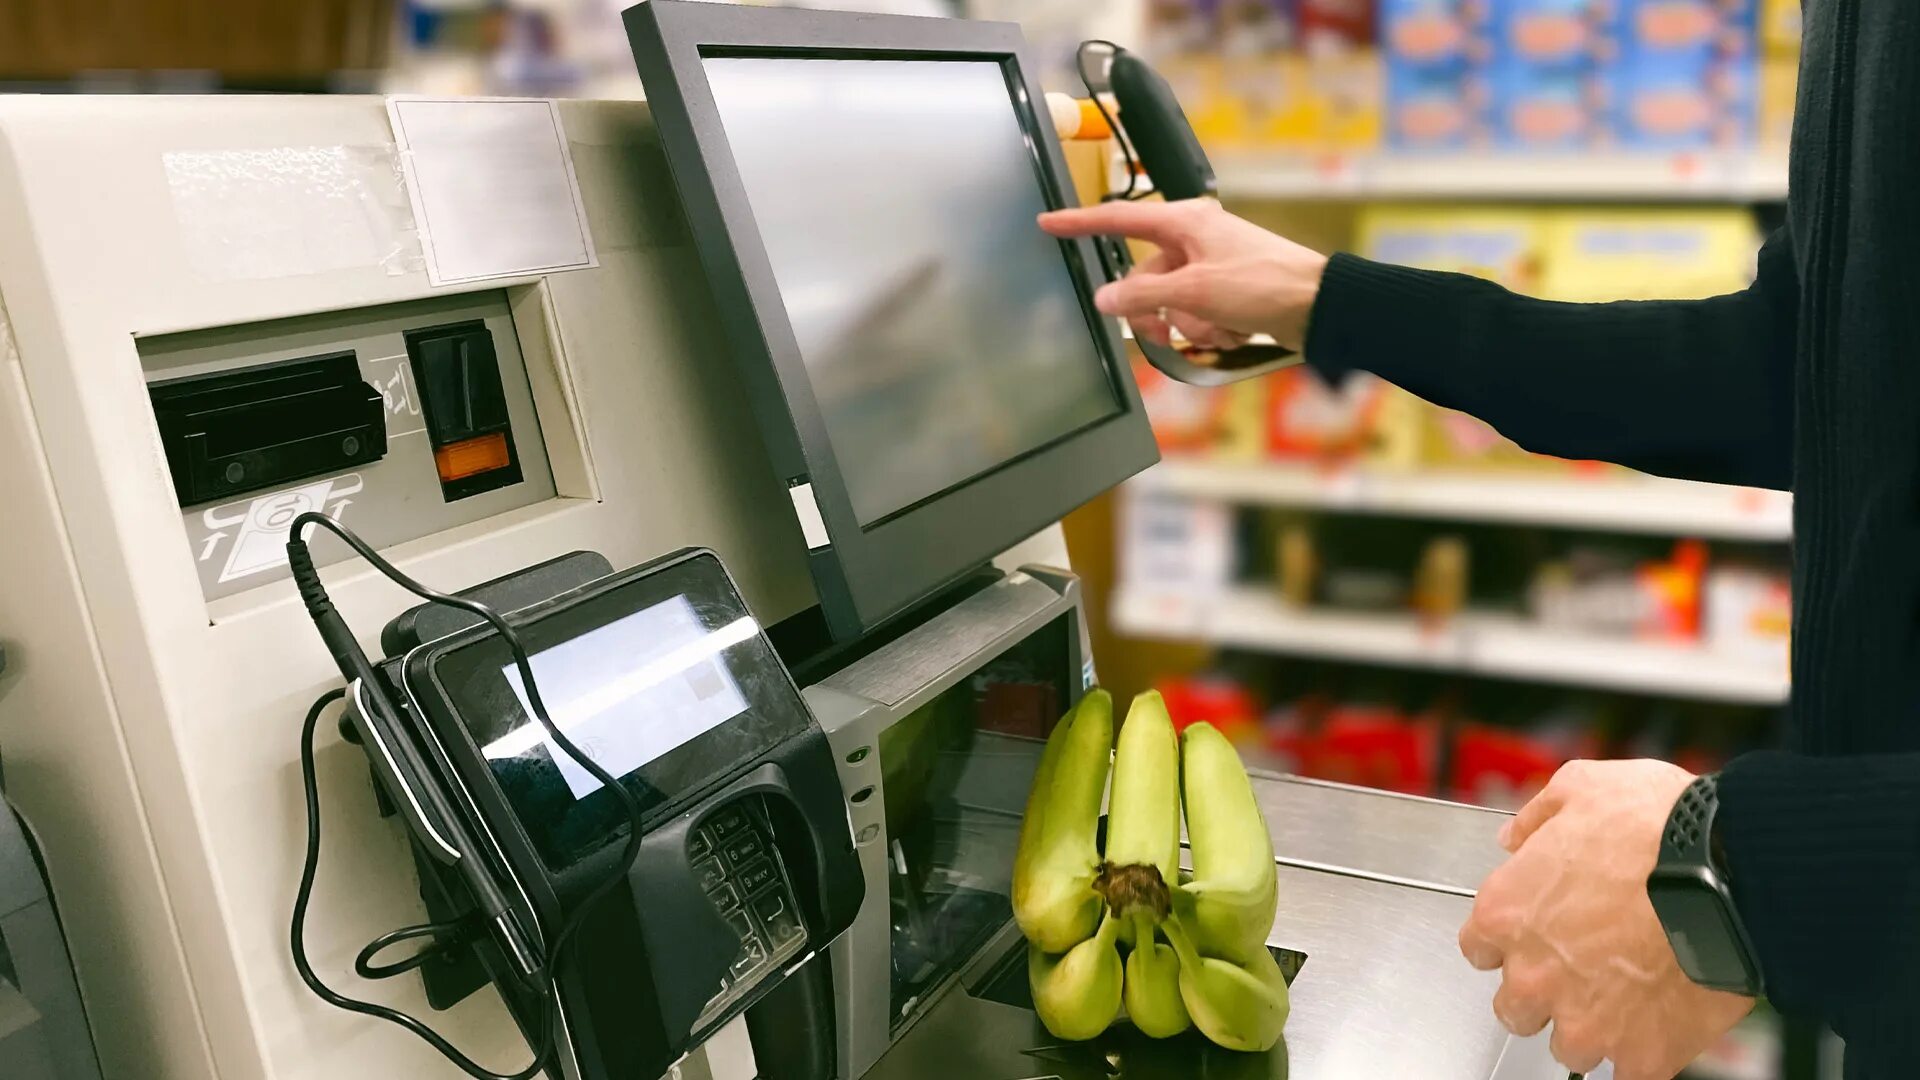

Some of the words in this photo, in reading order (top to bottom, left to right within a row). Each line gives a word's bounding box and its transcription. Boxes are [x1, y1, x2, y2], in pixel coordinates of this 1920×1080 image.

[716, 823, 724, 834] 3
[730, 850, 738, 860] 6
[744, 877, 752, 887] 9
